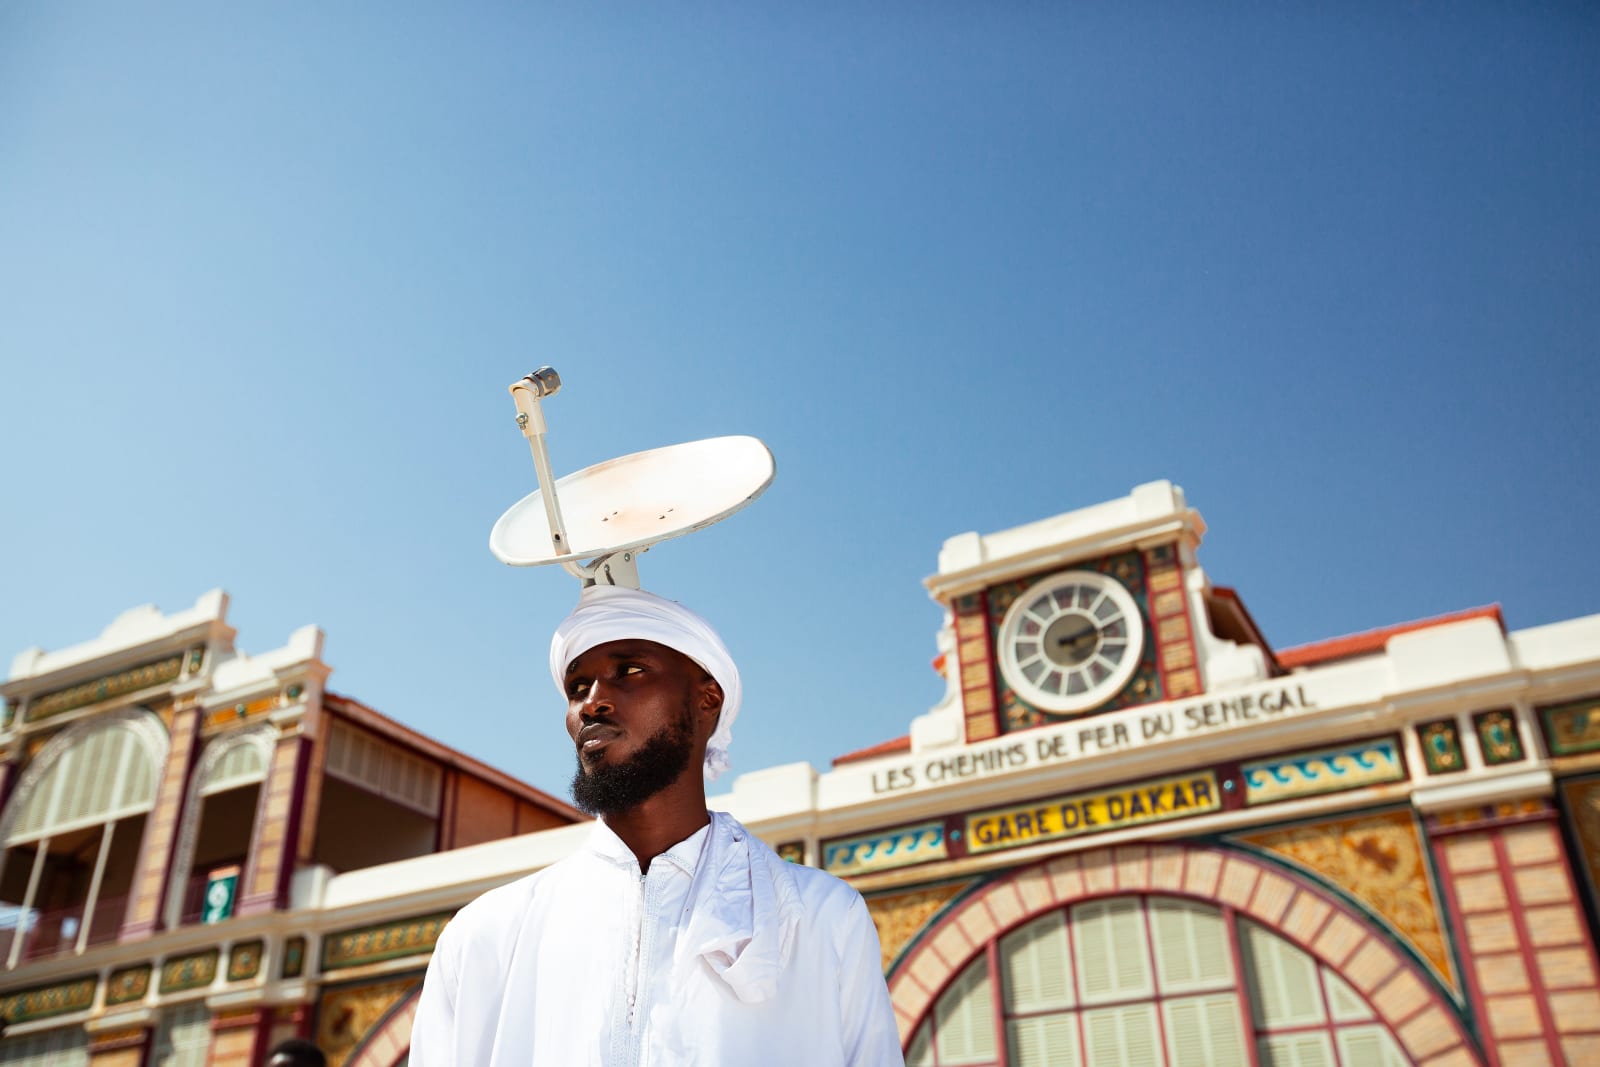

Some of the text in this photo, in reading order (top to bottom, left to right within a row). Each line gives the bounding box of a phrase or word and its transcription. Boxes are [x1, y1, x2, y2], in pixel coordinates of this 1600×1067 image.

[872, 685, 1316, 794] LES CHEMINS DE FER DU SENEGAL
[976, 780, 1213, 844] GARE DE DAKAR
